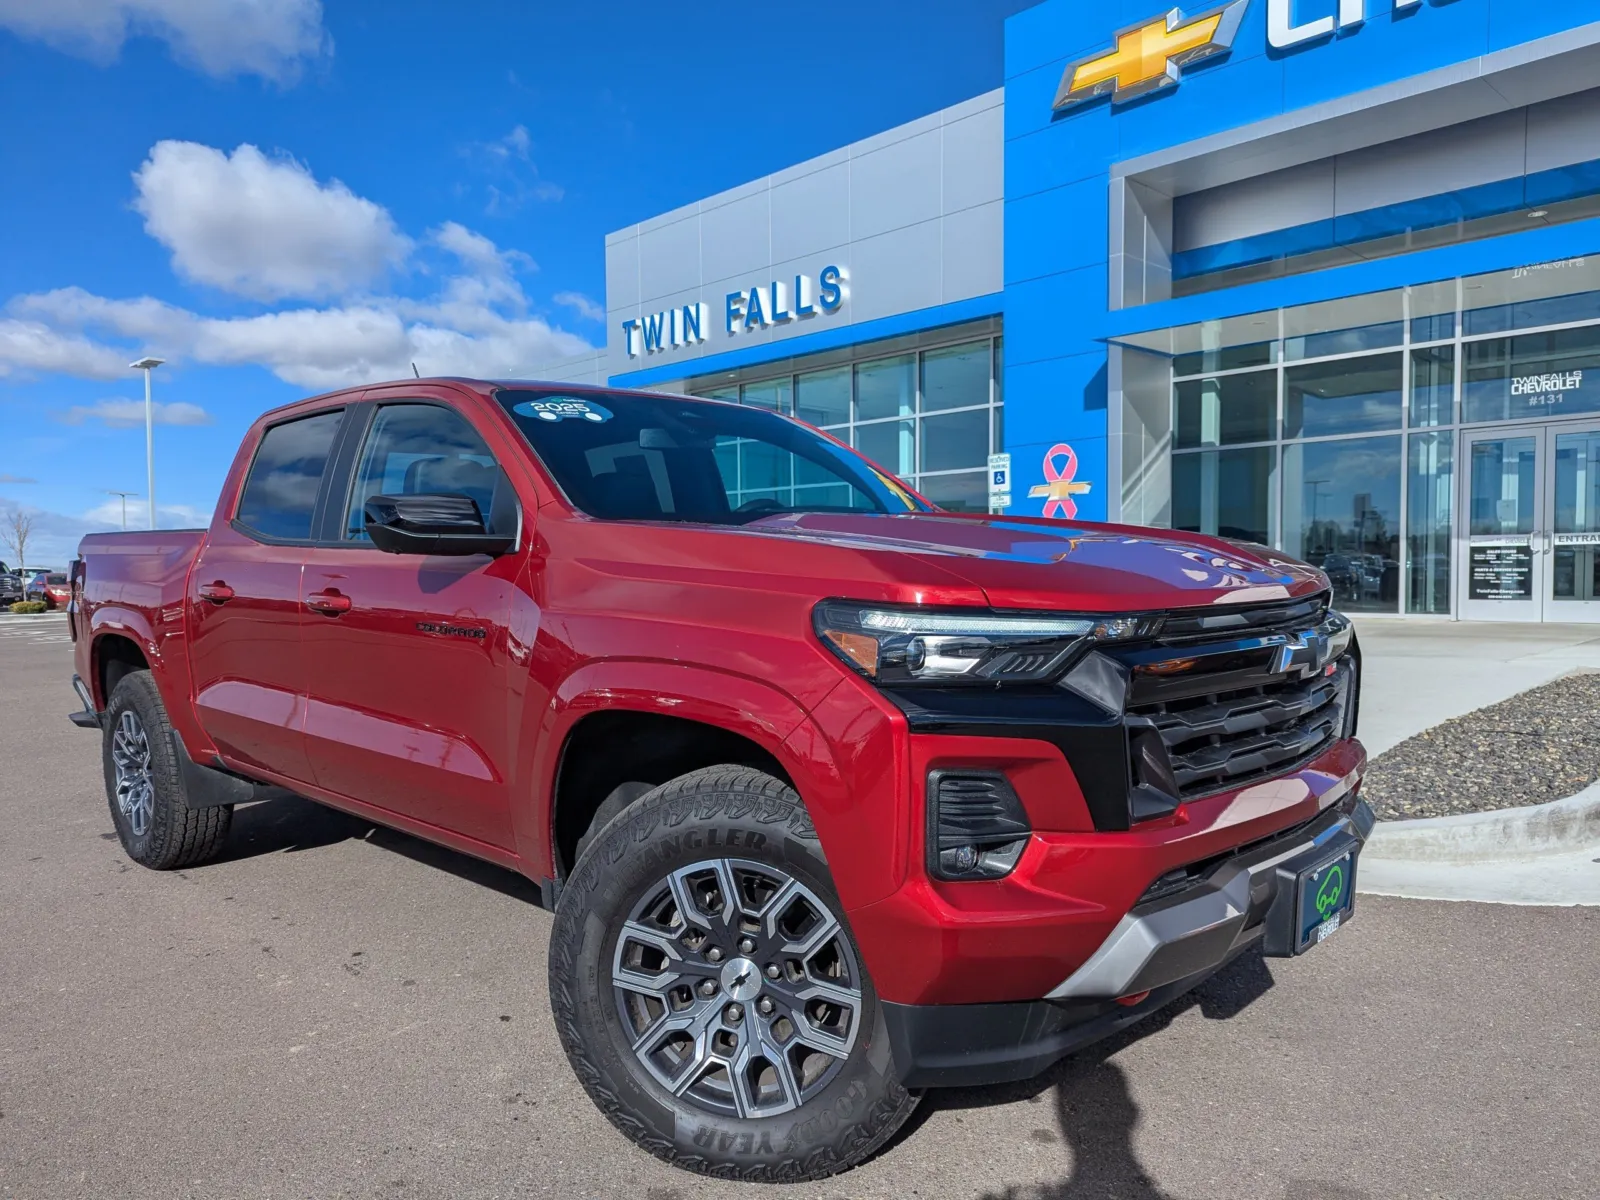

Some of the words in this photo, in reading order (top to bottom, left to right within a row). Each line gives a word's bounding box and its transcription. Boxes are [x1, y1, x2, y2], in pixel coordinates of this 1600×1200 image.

[622, 302, 705, 357] TWIN
[725, 265, 845, 335] FALLS
[1511, 377, 1582, 395] CHEVROLET
[1528, 393, 1564, 406] #131
[530, 402, 591, 412] 2025
[1558, 534, 1600, 543] ENTRA
